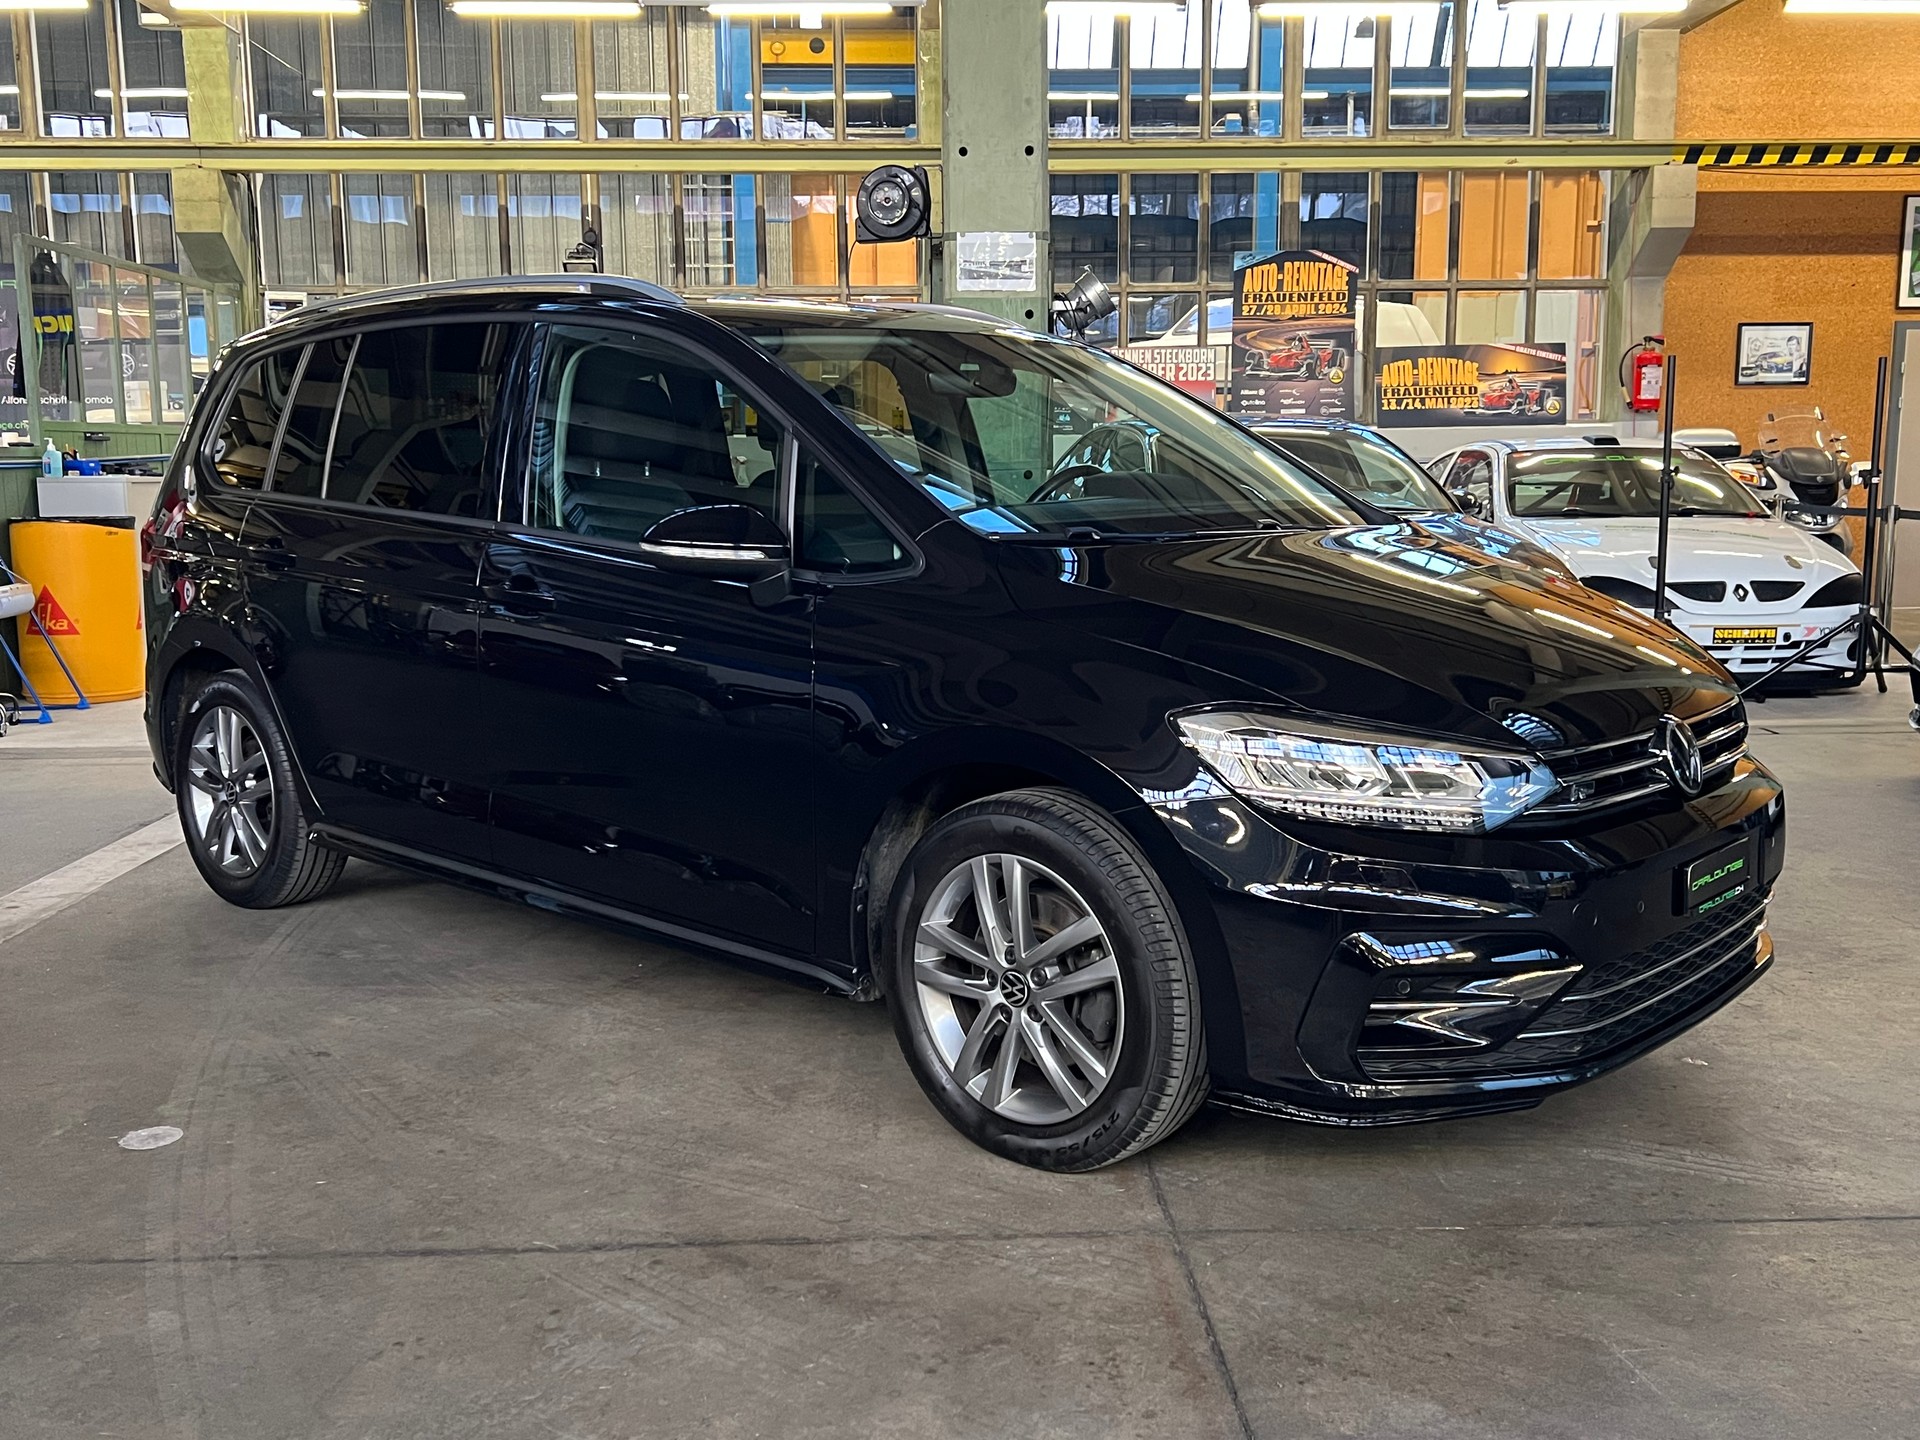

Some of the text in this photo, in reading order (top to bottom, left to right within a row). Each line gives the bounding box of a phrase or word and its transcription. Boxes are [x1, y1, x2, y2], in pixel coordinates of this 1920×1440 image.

[1243, 261, 1349, 292] AUTO-RENNTAGE
[1243, 291, 1348, 304] FRAUENFELD
[1318, 303, 1347, 315] 2024
[1153, 348, 1215, 363] STECKBORN
[1178, 363, 1215, 381] 2023
[1382, 357, 1479, 387] AUTO-RENNTAGE
[1382, 385, 1479, 398] FRAUENFELD
[1449, 397, 1479, 409] 2023
[1714, 628, 1777, 639] SCHROTH
